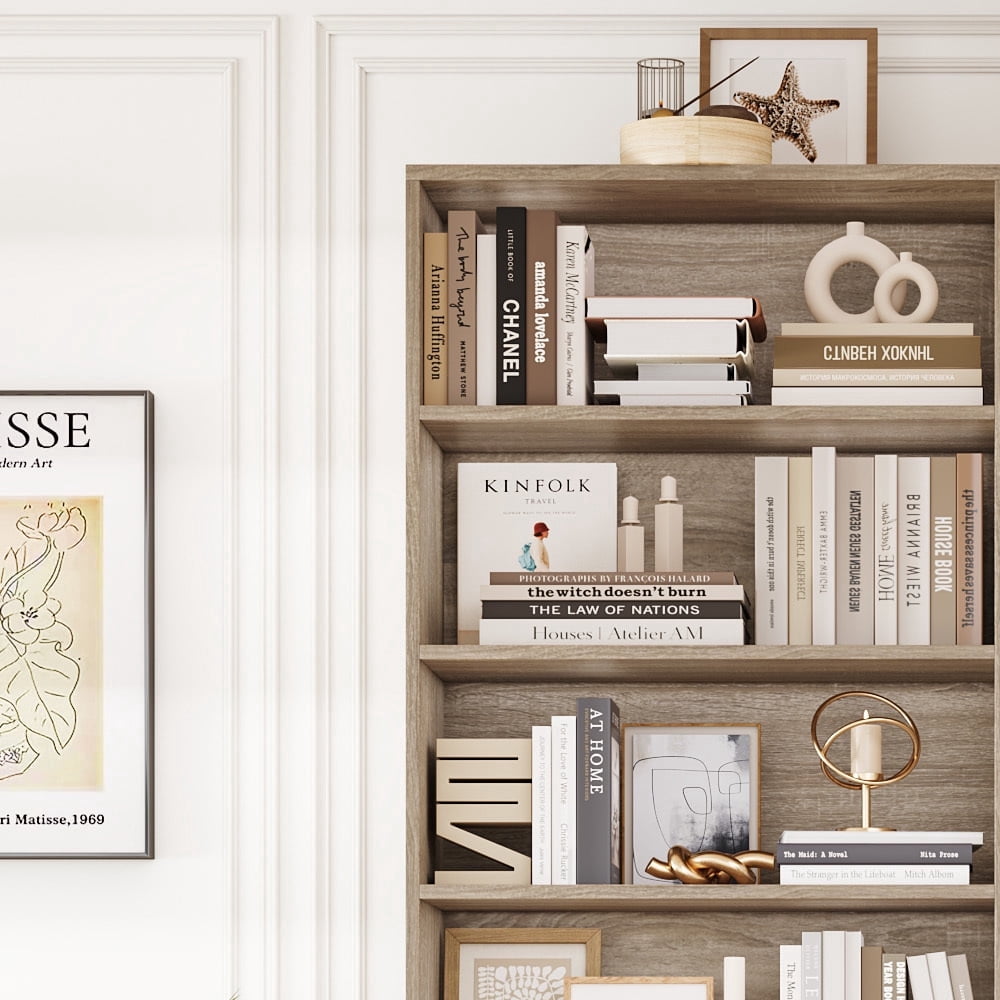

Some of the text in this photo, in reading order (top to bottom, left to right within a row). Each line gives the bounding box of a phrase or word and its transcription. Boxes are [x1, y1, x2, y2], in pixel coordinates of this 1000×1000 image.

[560, 241, 580, 324] Karen McCartney
[426, 264, 446, 380] Arianna Huffington
[534, 261, 550, 363] amanda lovelace
[502, 299, 520, 383] CHANEL
[0, 411, 92, 449] SSE
[31, 457, 53, 469] Art
[484, 478, 591, 493] KINFOLK
[519, 574, 711, 585] PHOTOGRAPHS BY FRANÇOIS HALARD
[529, 605, 700, 616] THE LAW OF NATIONS
[532, 626, 703, 641] Houses Atelier AM
[589, 708, 604, 795] AT HOME
[896, 961, 906, 992] DESIGN
